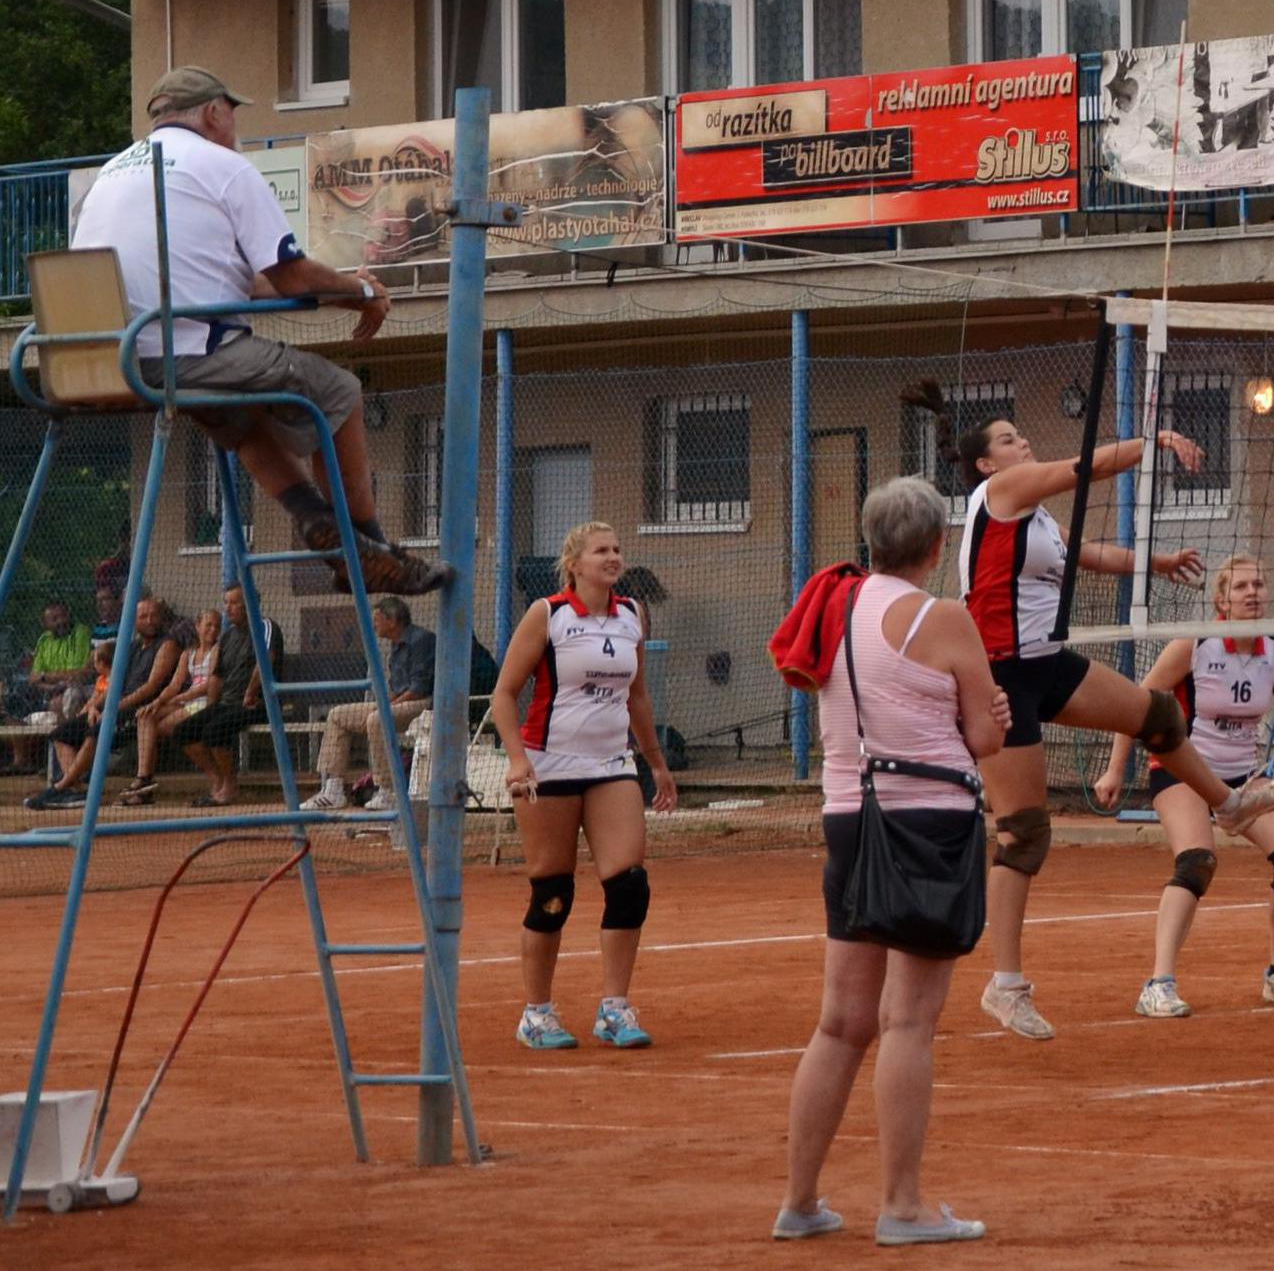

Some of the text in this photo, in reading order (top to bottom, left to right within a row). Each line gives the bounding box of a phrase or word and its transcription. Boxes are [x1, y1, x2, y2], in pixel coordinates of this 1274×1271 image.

[877, 70, 1073, 112] reklamní agentura
[705, 101, 793, 138] od razítka
[780, 134, 893, 177] po billboard
[975, 127, 1070, 184] Stillus
[986, 187, 1069, 210] www.stillus.cz
[602, 637, 616, 659] 4
[1231, 679, 1252, 704] 16
